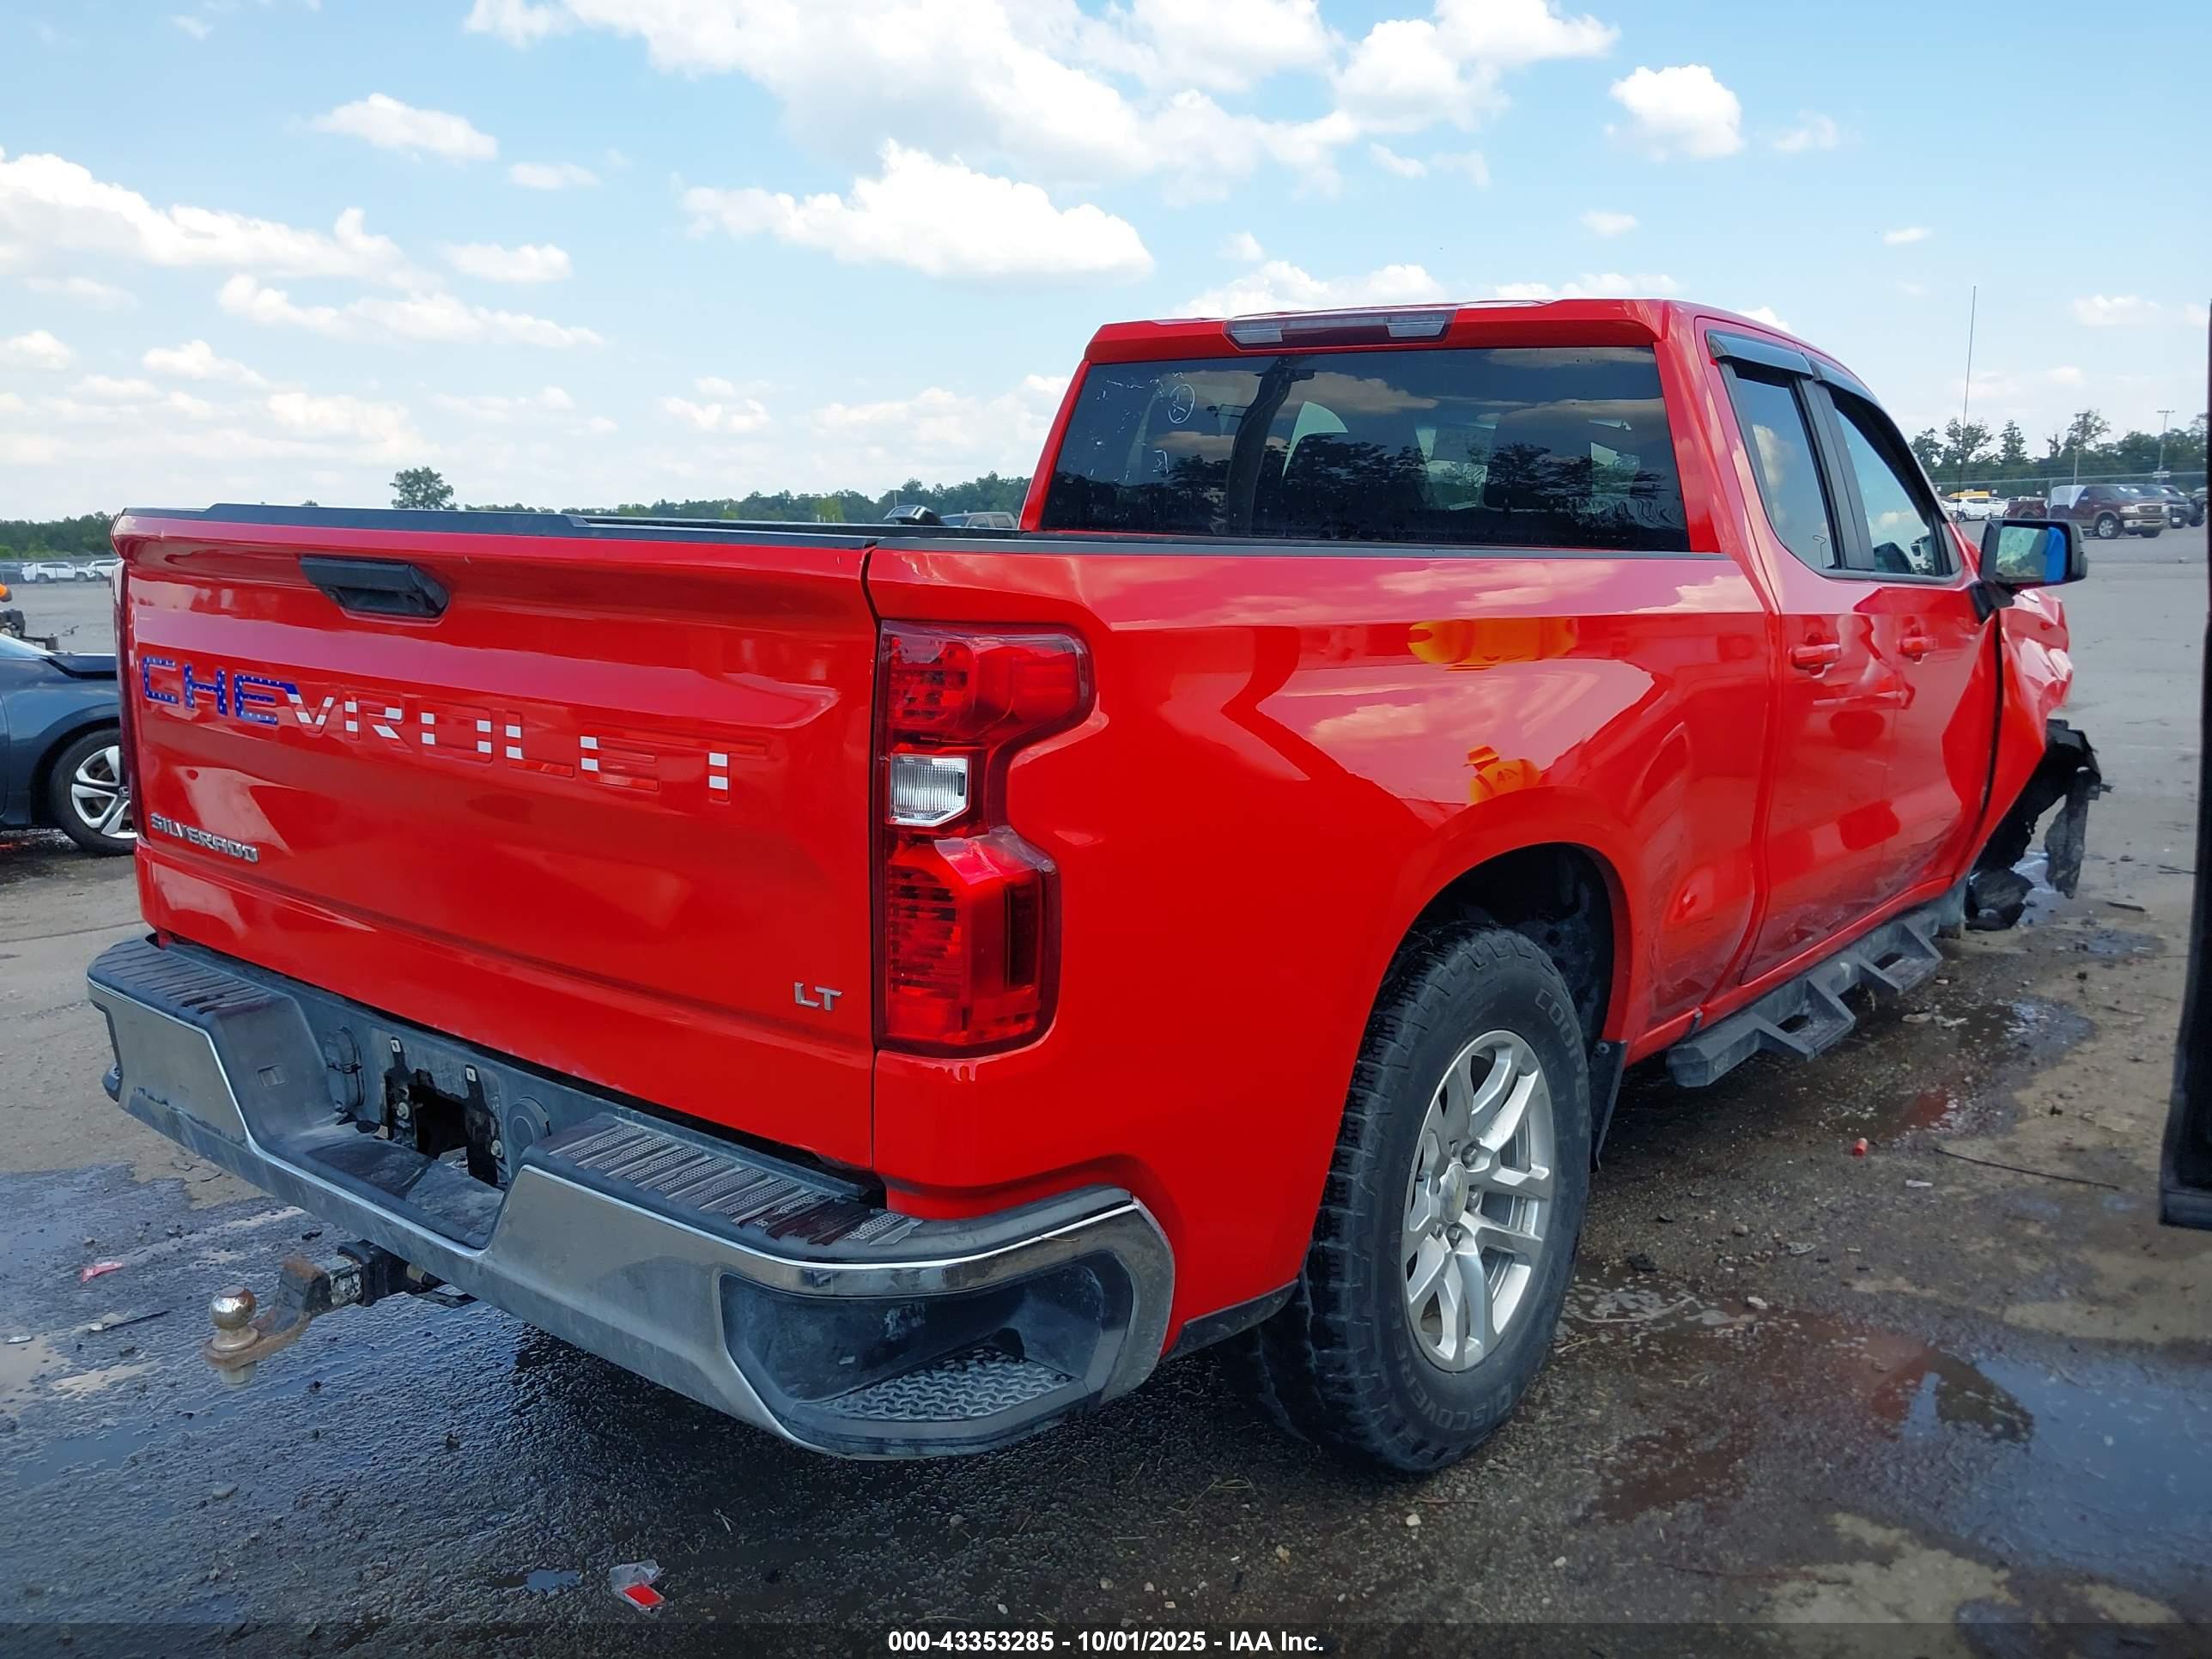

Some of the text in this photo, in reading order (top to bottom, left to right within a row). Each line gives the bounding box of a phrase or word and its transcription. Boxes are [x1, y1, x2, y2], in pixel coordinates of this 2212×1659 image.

[143, 656, 768, 801] CHEVROLET
[150, 811, 258, 863] SILVERADO
[794, 981, 842, 1011] LT
